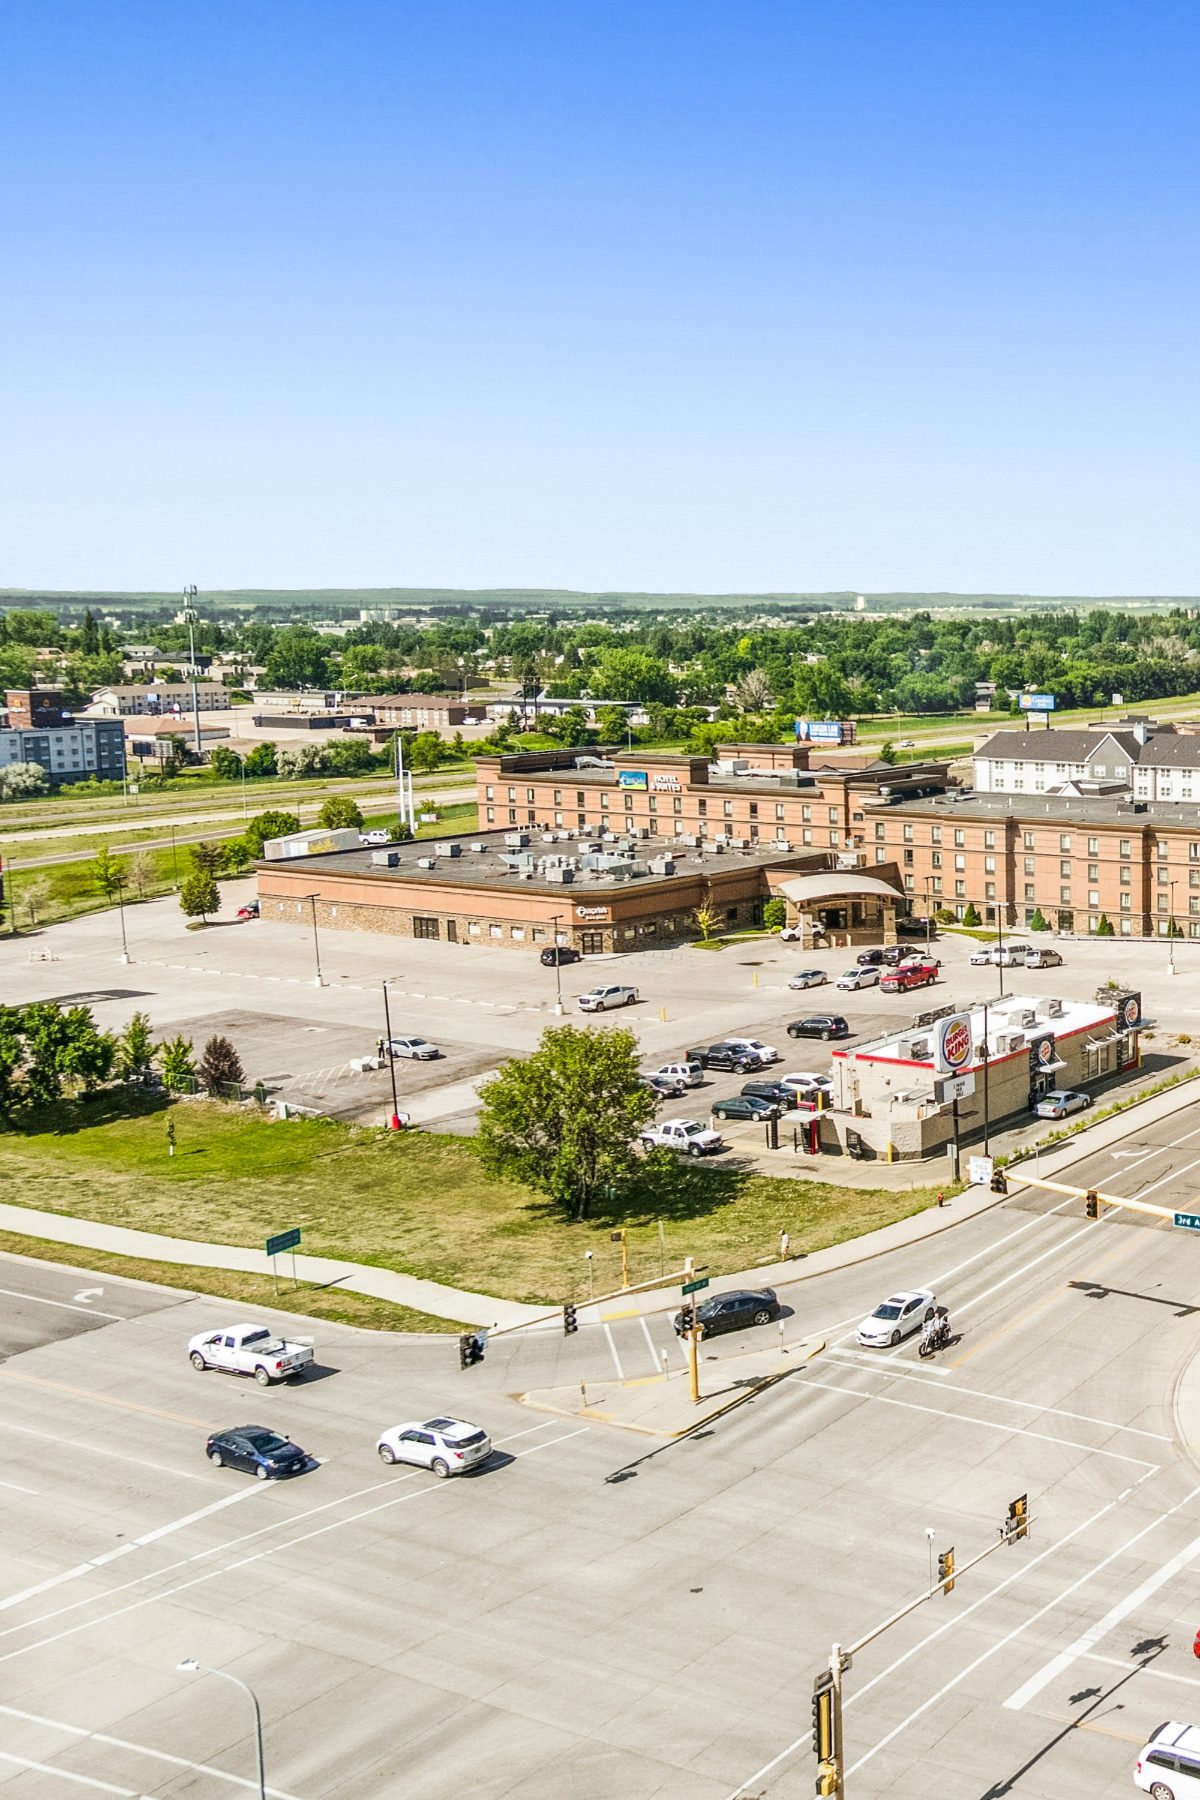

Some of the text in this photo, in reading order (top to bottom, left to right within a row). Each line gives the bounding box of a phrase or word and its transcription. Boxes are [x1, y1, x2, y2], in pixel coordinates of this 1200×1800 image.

[654, 774, 678, 783] HOTEL
[945, 1023, 968, 1047] BURGER
[946, 1035, 969, 1060] KING
[1177, 1216, 1190, 1226] 3rd
